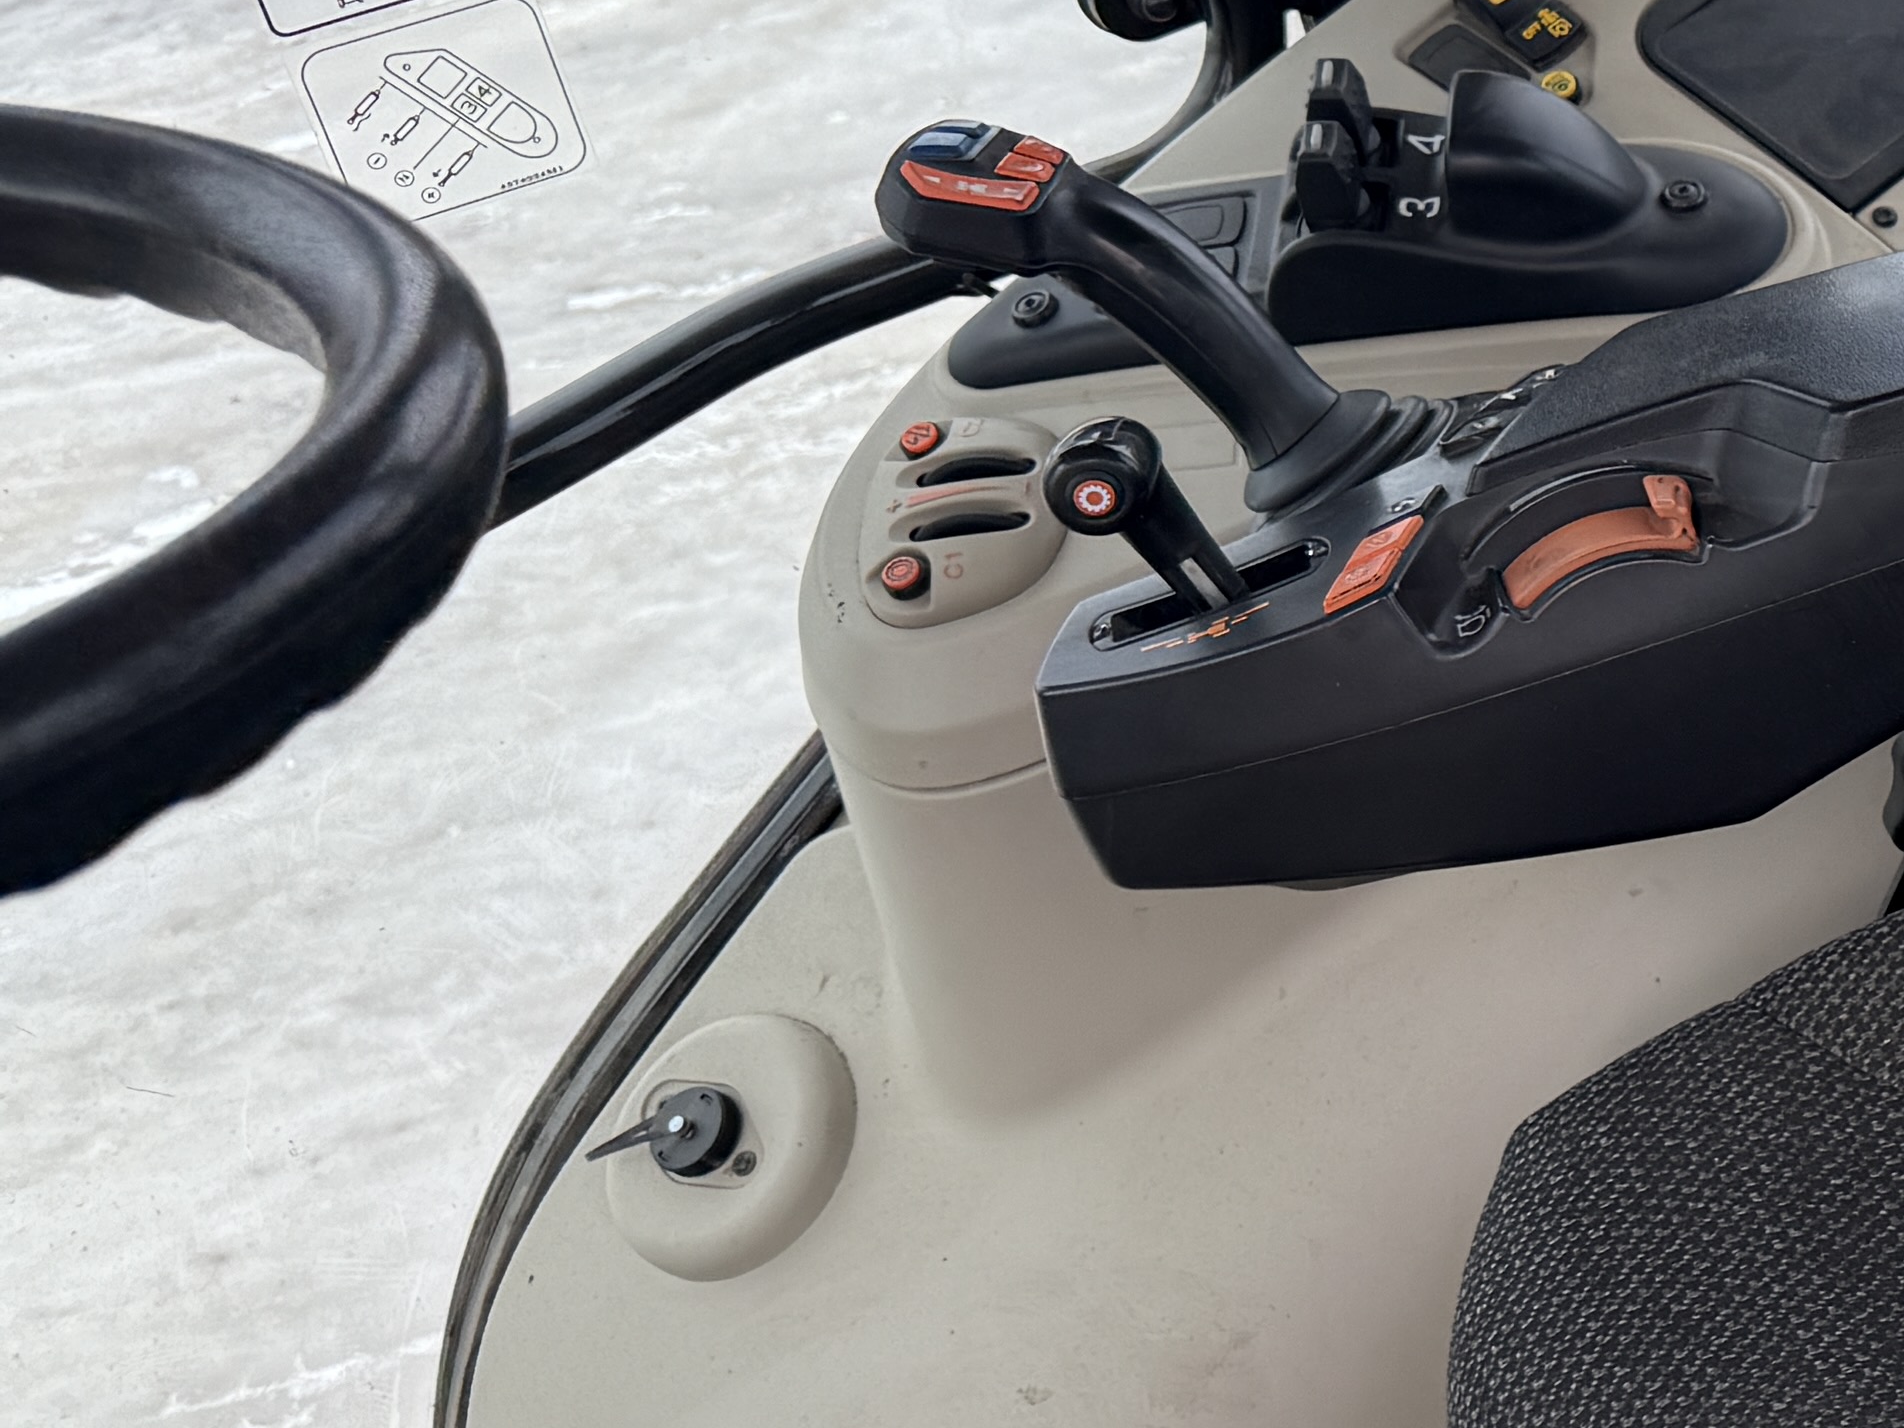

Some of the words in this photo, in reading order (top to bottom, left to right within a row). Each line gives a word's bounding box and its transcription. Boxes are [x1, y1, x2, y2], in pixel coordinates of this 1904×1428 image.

[1522, 21, 1541, 40] OFF
[478, 84, 492, 98] 4
[460, 100, 478, 115] 3
[1405, 134, 1446, 155] 4
[1399, 196, 1441, 218] 3
